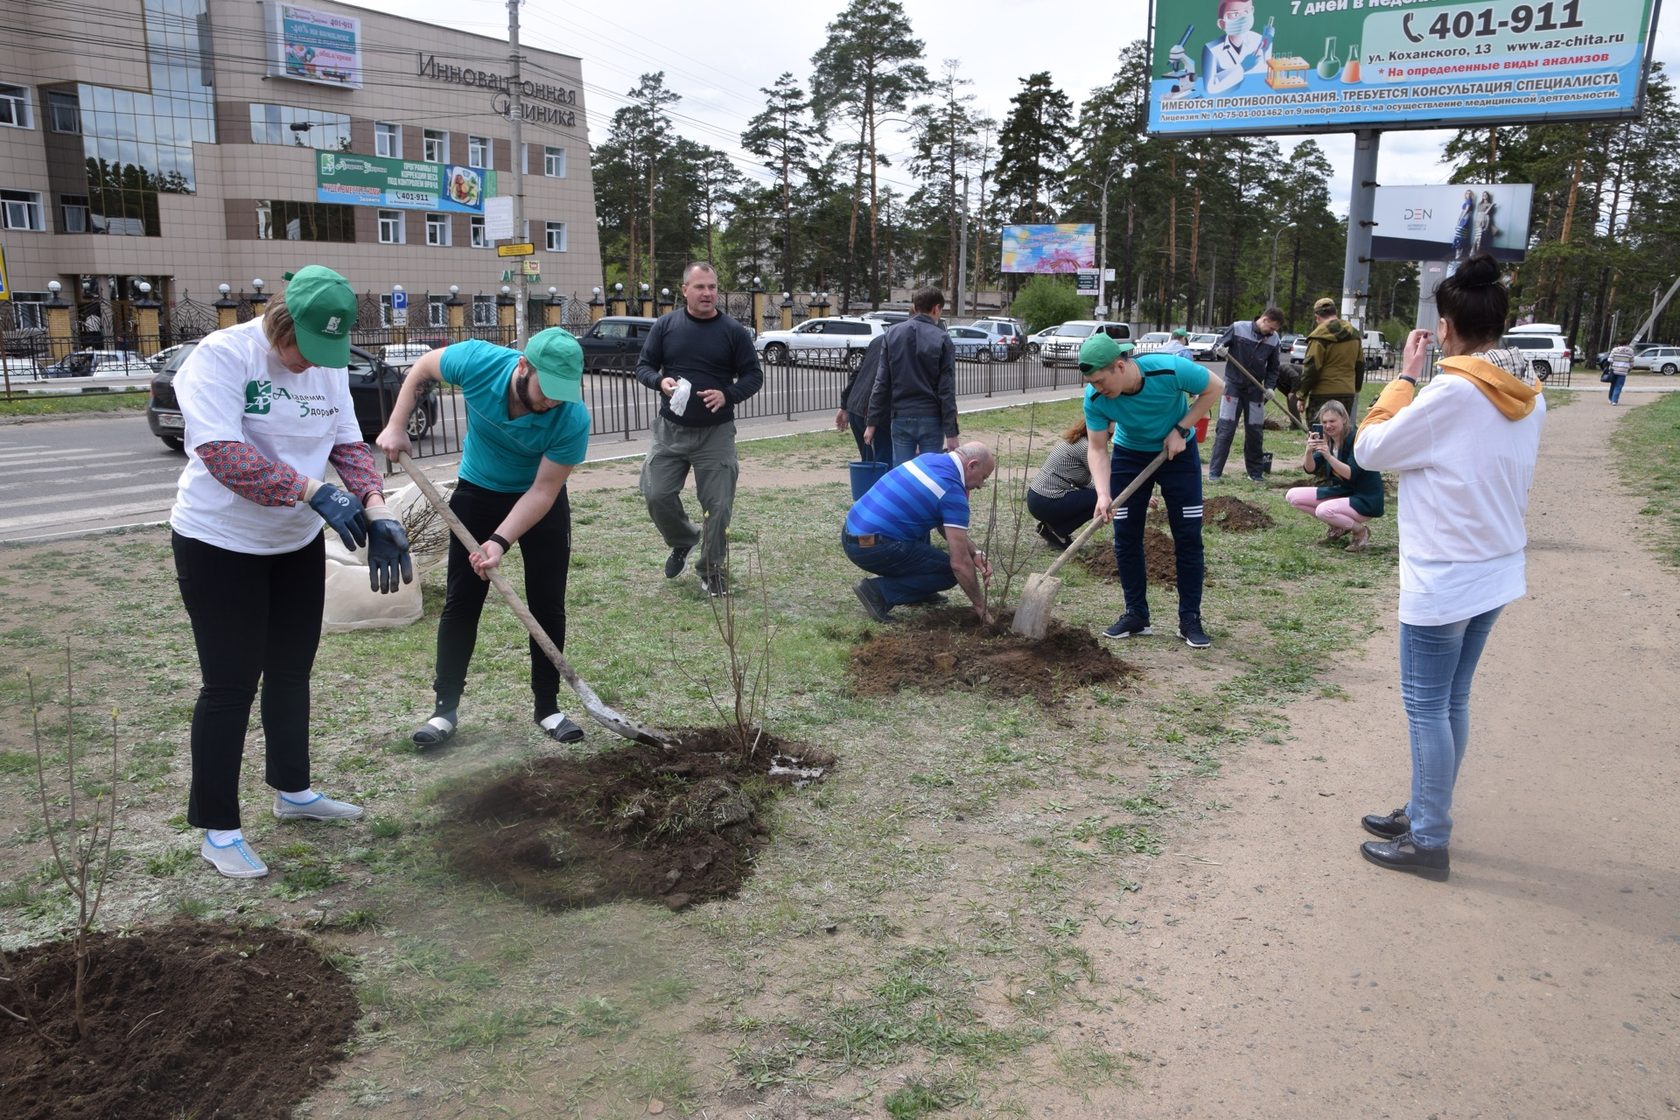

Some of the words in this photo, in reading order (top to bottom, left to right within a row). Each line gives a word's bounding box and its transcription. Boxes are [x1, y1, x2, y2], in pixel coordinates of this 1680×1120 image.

[1291, 0, 1301, 15] 7
[1304, 0, 1348, 16] дней
[1353, 0, 1364, 9] в
[1429, 0, 1584, 40] 401-911
[1368, 54, 1385, 64] ул.
[1388, 47, 1470, 61] Коханского,
[1474, 43, 1492, 54] 13
[1506, 33, 1625, 52] www.az-chita.ru
[1388, 67, 1404, 77] На
[1407, 61, 1499, 77] определенные
[1503, 58, 1539, 71] виды
[1542, 52, 1610, 67] анализов
[417, 51, 576, 105] Инновацонная
[1161, 99, 1214, 111] ИМЕЮТСЯ
[1216, 91, 1340, 108] ПРОТИВОПОКАЗАНИЯ.
[1343, 88, 1408, 101] ТРЕБУЕТСЯ
[1412, 81, 1513, 97] КОНСУЛЬТАЦИЯ
[1516, 73, 1619, 91] СПЕЦИАЛИСТА
[1304, 105, 1336, 115] ноября
[1339, 104, 1361, 112] 2018
[1386, 100, 1462, 110] осуществление
[1465, 95, 1536, 107] медицинской
[1539, 90, 1619, 103] деятельности.
[401, 192, 429, 201] 401-911
[1404, 208, 1432, 220] DEN
[394, 293, 404, 308] P
